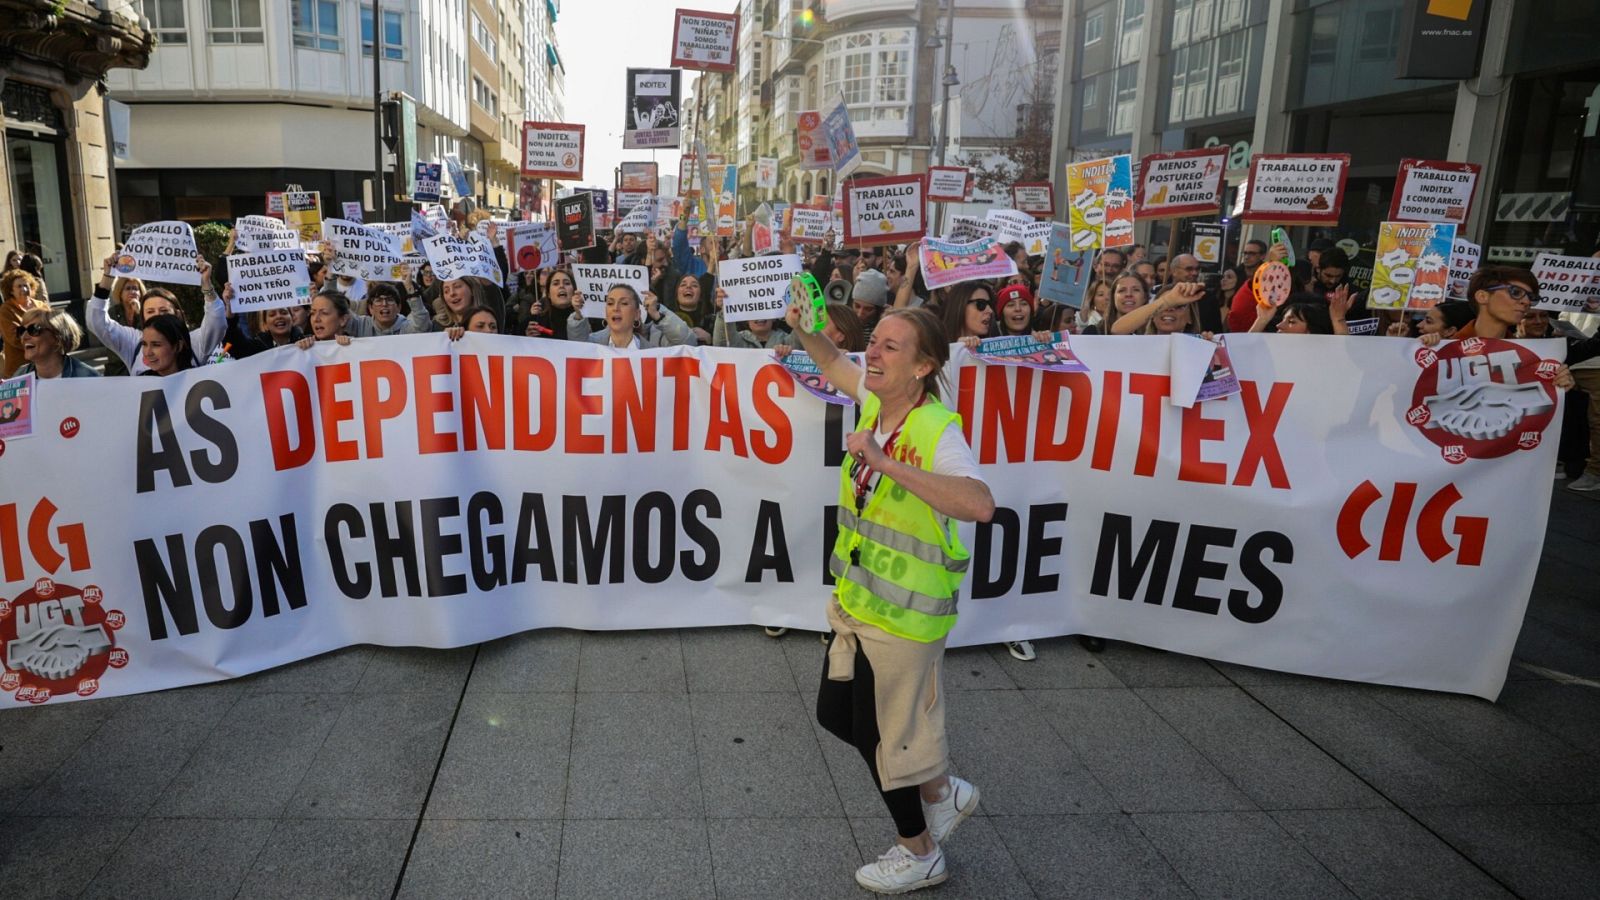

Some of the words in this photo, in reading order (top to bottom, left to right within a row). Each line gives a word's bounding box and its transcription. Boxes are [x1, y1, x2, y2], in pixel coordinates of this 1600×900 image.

[683, 17, 700, 26] NON
[701, 20, 727, 28] SOMOS
[1421, 28, 1473, 36] www.fnac.es
[639, 81, 667, 89] INDITEX
[537, 132, 570, 141] INDITEX
[1157, 160, 1198, 171] MENOS
[1261, 163, 1318, 172] TRABALLO
[1320, 164, 1336, 172] EN
[1149, 172, 1203, 183] POSTUREO
[1413, 171, 1457, 182] TRABALLO
[1458, 174, 1471, 183] EN
[1175, 182, 1203, 191] MAIS
[1256, 185, 1261, 193] E
[1263, 186, 1317, 194] COBRAMOS
[1319, 186, 1334, 194] UN
[1420, 184, 1454, 194] INDITEX
[855, 186, 914, 200] TRABALLO
[1168, 191, 1214, 203] DIÑEIRO
[1274, 196, 1308, 206] MOJÓN
[1412, 195, 1436, 204] COMO
[1436, 197, 1463, 206] ARROZ
[865, 202, 879, 211] EN
[1402, 206, 1422, 214] TODO
[1431, 208, 1446, 216] MES
[887, 208, 915, 220] CARA
[134, 225, 182, 236] RABALLO
[250, 232, 295, 240] TRABALLO
[131, 235, 154, 243] ARA
[161, 238, 192, 246] HOM
[259, 240, 270, 248] EN
[273, 240, 292, 248] PULL
[343, 239, 360, 249] EN
[365, 240, 391, 252] PULL
[125, 244, 153, 255] NON
[156, 246, 198, 259] COBRO
[445, 245, 462, 253] EN
[1467, 246, 1479, 257] EN
[138, 259, 153, 268] UN
[229, 253, 287, 268] TRABALLO
[290, 252, 304, 261] EN
[373, 255, 385, 263] DE
[741, 259, 783, 272] SOMOS
[240, 265, 296, 279] PULL&BEAR
[577, 267, 642, 280] TRABALLO
[1349, 265, 1373, 279] OFERT
[1537, 270, 1600, 284] INDITE
[239, 283, 262, 292] NON
[265, 279, 290, 291] TEÑO
[589, 282, 604, 292] EN
[1538, 282, 1569, 293] OMO
[238, 295, 265, 305] PARA
[266, 291, 293, 302] VIVIR
[583, 293, 608, 302] POL
[748, 287, 775, 299] NON
[725, 300, 783, 314] INVISIBLES
[1562, 297, 1585, 307] MES
[1437, 349, 1522, 395] UGT
[1407, 405, 1429, 421] UGT
[136, 379, 240, 494] AS
[259, 353, 796, 472] DEPENDENTAS
[956, 365, 1296, 490] INDITEX
[1443, 444, 1465, 455] UGT
[1336, 479, 1489, 567] CIG
[0, 495, 92, 584] IG
[133, 512, 308, 641] NON
[324, 488, 722, 600] CHEGAMOS
[745, 498, 795, 583] A
[970, 502, 1069, 600] DE
[1089, 511, 1295, 624] MES
[36, 580, 53, 591] UGT
[84, 588, 101, 598] UGT
[16, 594, 86, 639] UGT
[106, 612, 124, 622] UGT
[109, 650, 127, 660] UGT
